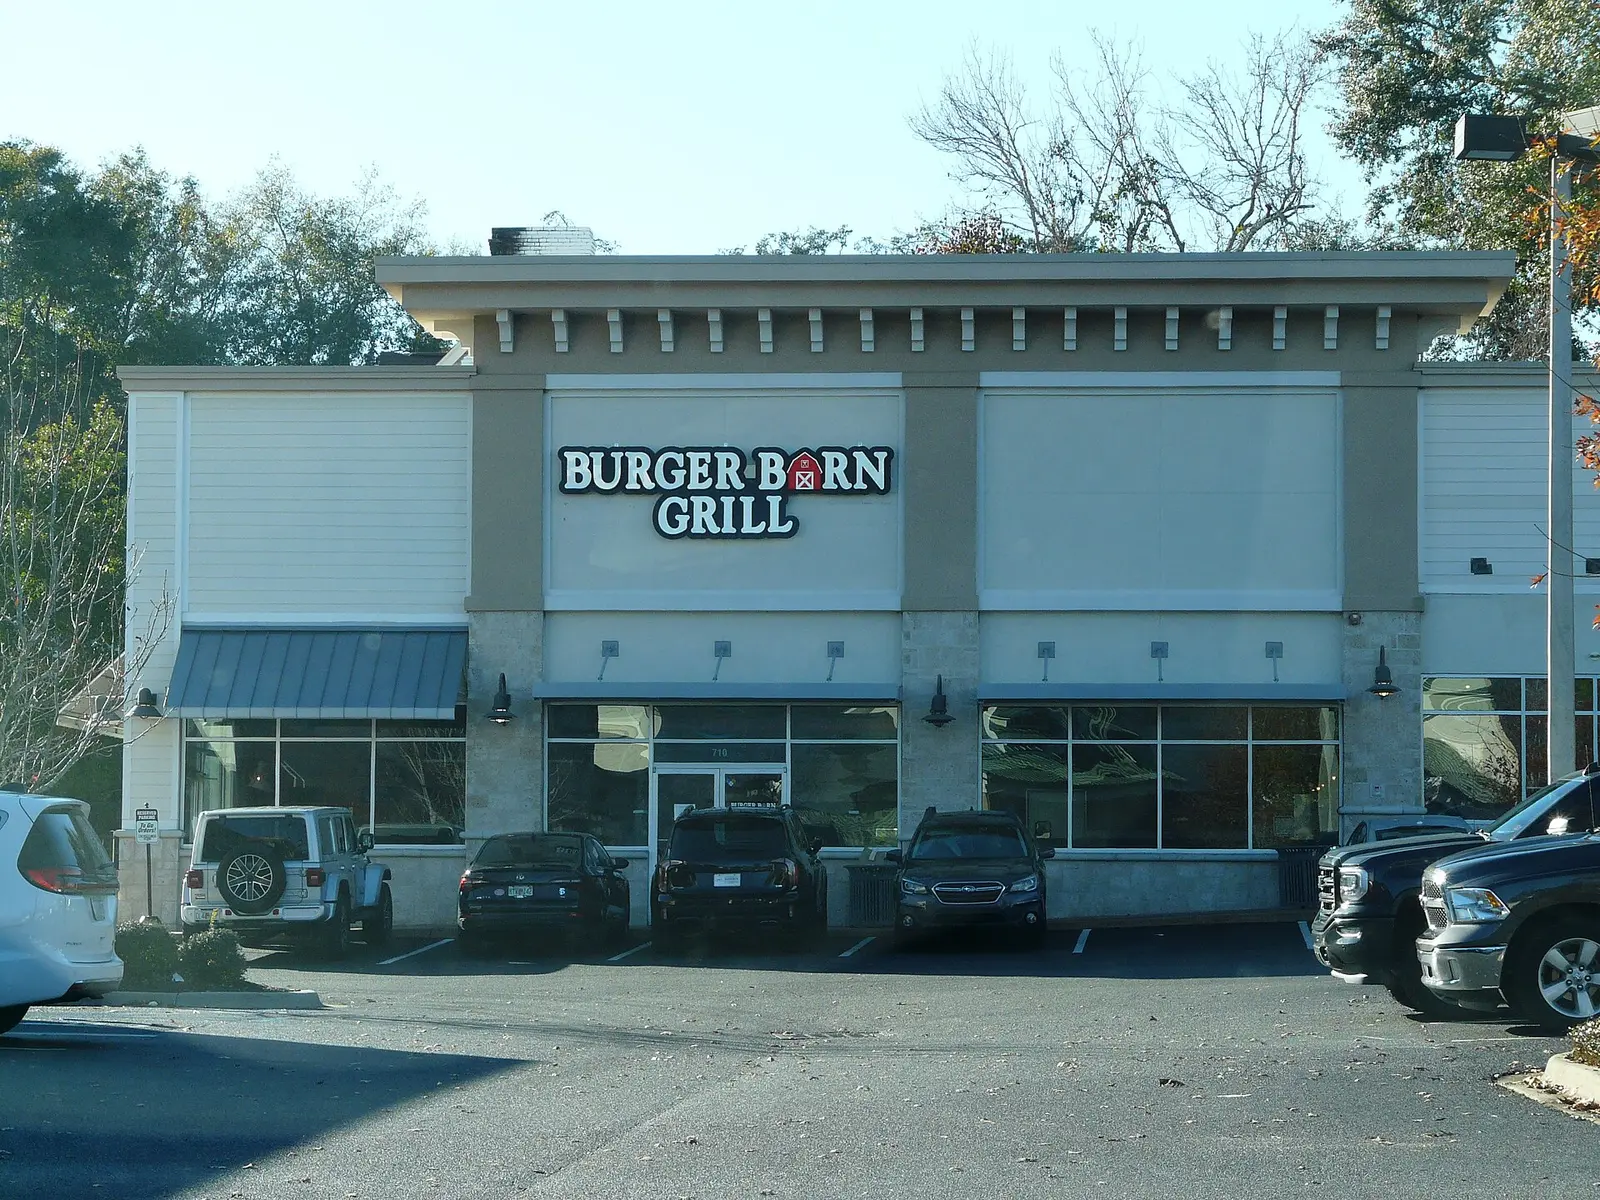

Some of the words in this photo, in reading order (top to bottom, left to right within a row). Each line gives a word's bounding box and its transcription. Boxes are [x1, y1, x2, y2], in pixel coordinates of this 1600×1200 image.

[563, 451, 745, 491] BURGER
[657, 495, 794, 535] GRILL
[712, 748, 728, 757] 710
